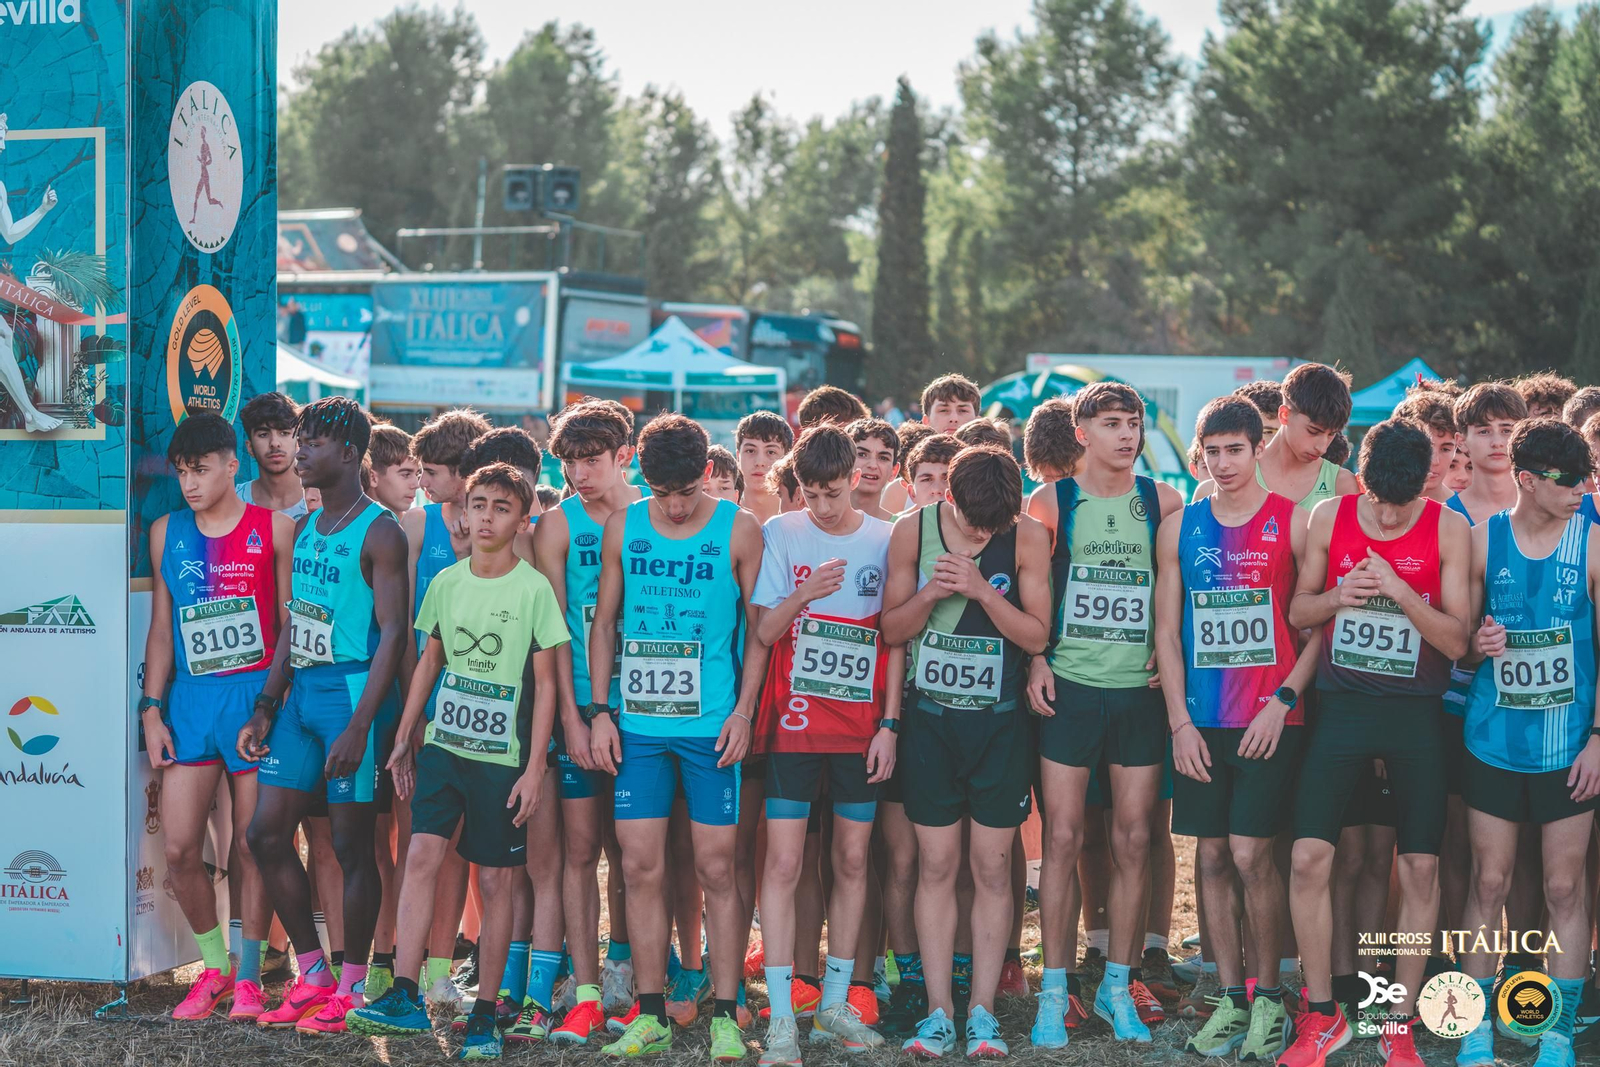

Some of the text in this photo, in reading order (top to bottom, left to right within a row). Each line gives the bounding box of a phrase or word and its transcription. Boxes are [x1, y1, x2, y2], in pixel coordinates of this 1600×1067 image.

[0, 279, 54, 317] ITÁLICA
[171, 293, 202, 351] GOLD LEVEL
[231, 337, 240, 366] TOUR
[193, 384, 216, 397] WORLD
[187, 396, 221, 410] ATHLETICS
[628, 540, 652, 553] TROPS
[292, 556, 341, 586] nerja
[629, 554, 715, 586] nerja
[1092, 567, 1133, 581] ITÁLICA
[640, 584, 702, 599] ATLETISMO
[1210, 591, 1249, 604] ITÁLICA
[199, 600, 237, 616] ITÁLICA
[490, 611, 519, 621] MARBELLA
[1073, 593, 1145, 624] 5963
[59, 627, 97, 635] ATLETISMO
[191, 622, 257, 656] 8103
[823, 623, 864, 640] ITÁLICA
[1200, 617, 1269, 646] 8100
[1340, 618, 1413, 655] 5951
[1510, 631, 1551, 644] ITÁLICA
[642, 642, 680, 654] ITÁLICA
[941, 636, 982, 650] ITÁLICA
[467, 657, 497, 672] Infinity
[801, 646, 871, 682] 5959
[1500, 656, 1570, 688] 6018
[627, 668, 695, 696] 8123
[924, 659, 996, 690] 6054
[459, 678, 495, 694] ITÁLICA
[441, 699, 508, 737] 8088
[1, 881, 70, 900] ITÁLICA
